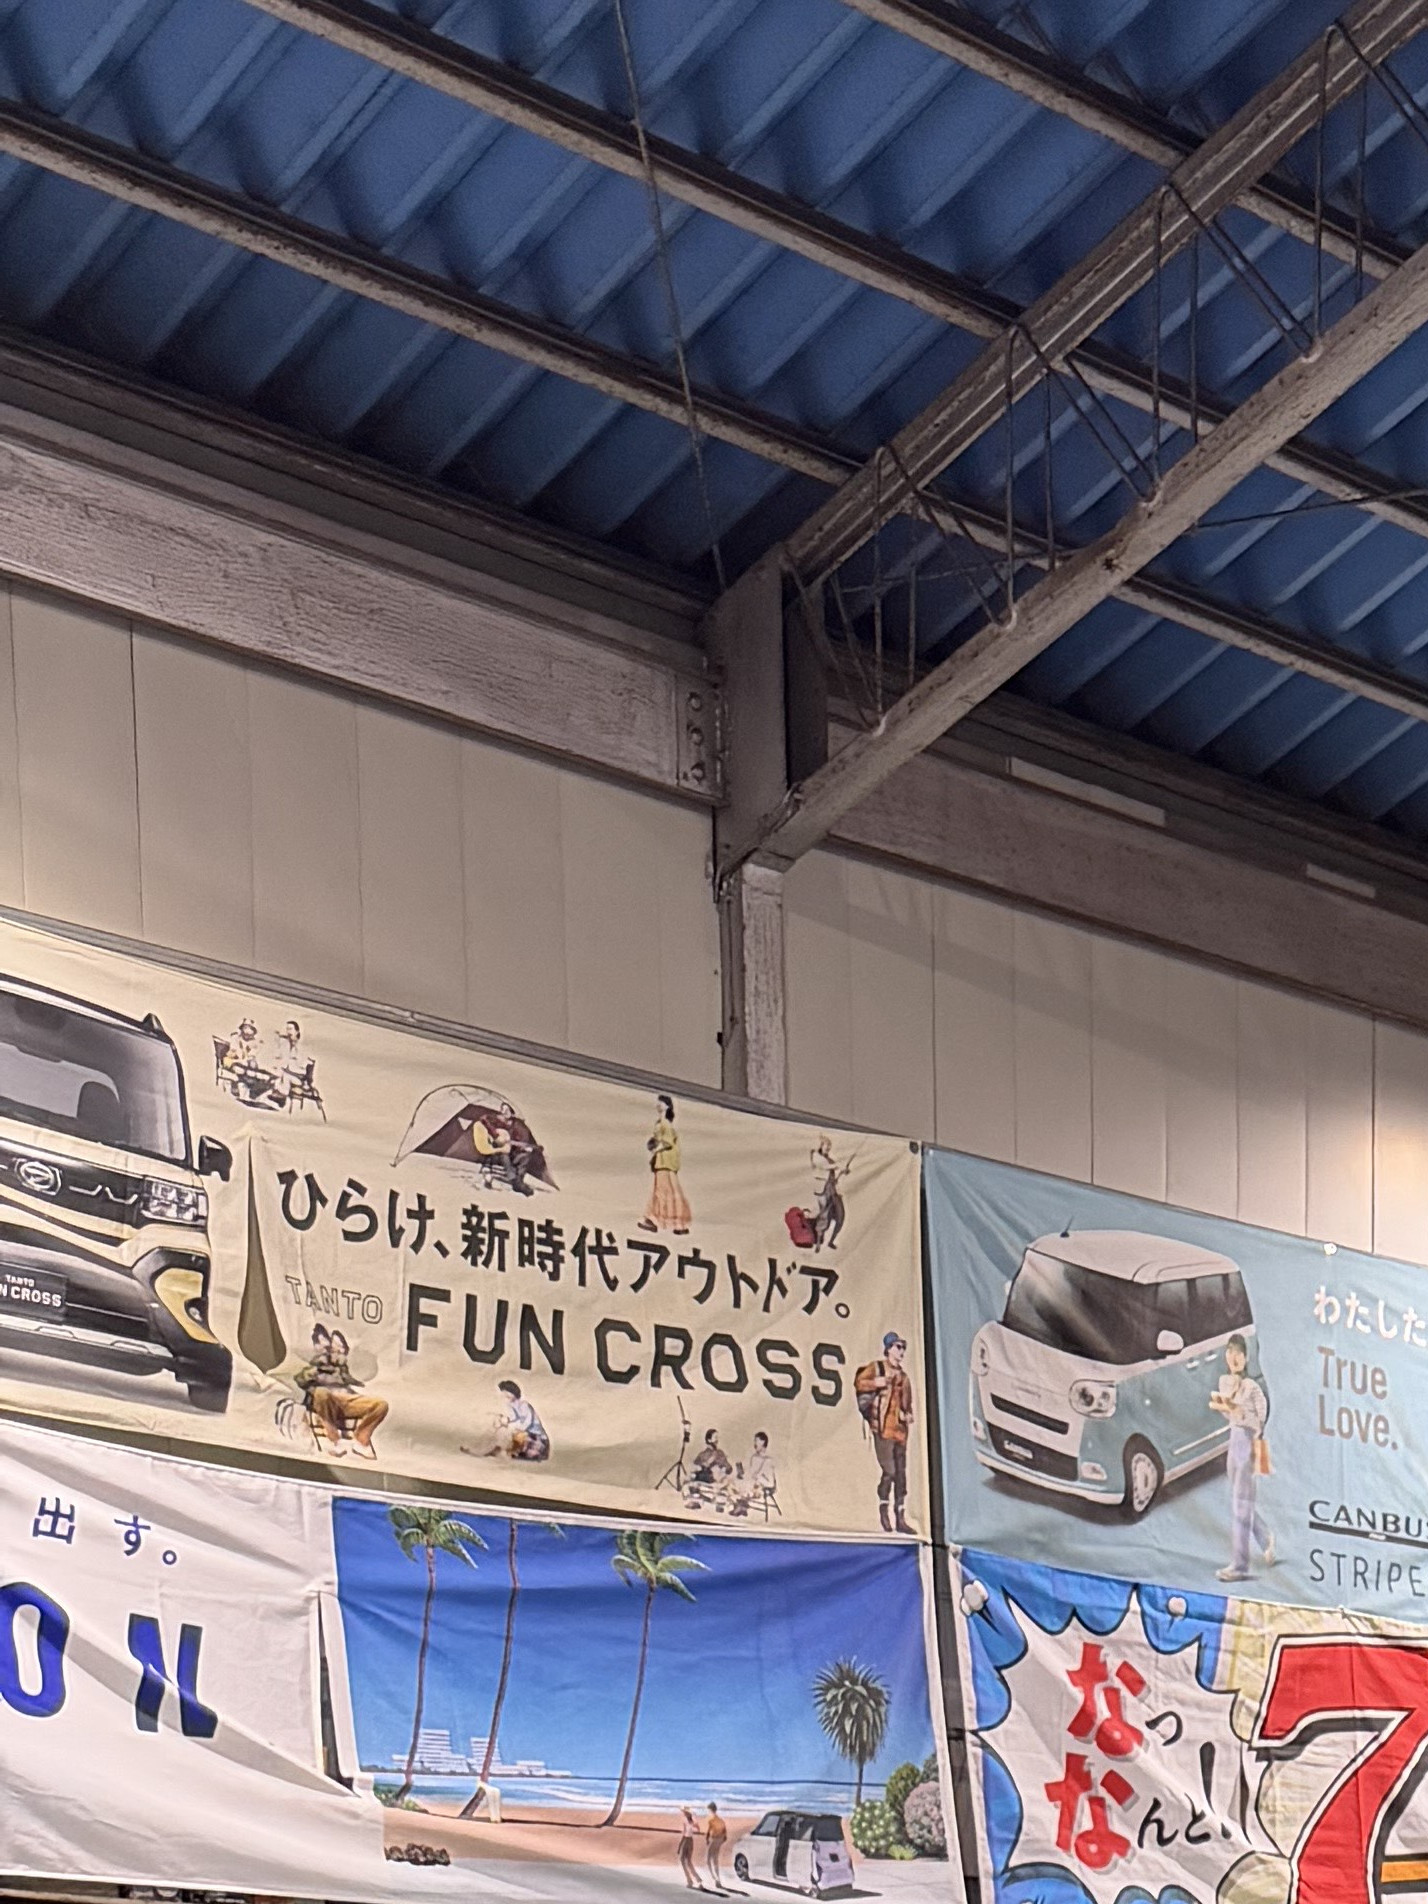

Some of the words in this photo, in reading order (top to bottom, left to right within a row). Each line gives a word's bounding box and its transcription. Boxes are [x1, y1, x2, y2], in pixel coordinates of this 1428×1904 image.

[278, 1168, 853, 1320] ひらけ、新時代アウトドア。
[10, 1286, 62, 1307] CROSS
[284, 1275, 384, 1327] TANTO
[406, 1284, 567, 1376] FUN
[593, 1318, 848, 1406] CROSS
[1317, 1346, 1388, 1400] True
[1317, 1393, 1399, 1450] Love.
